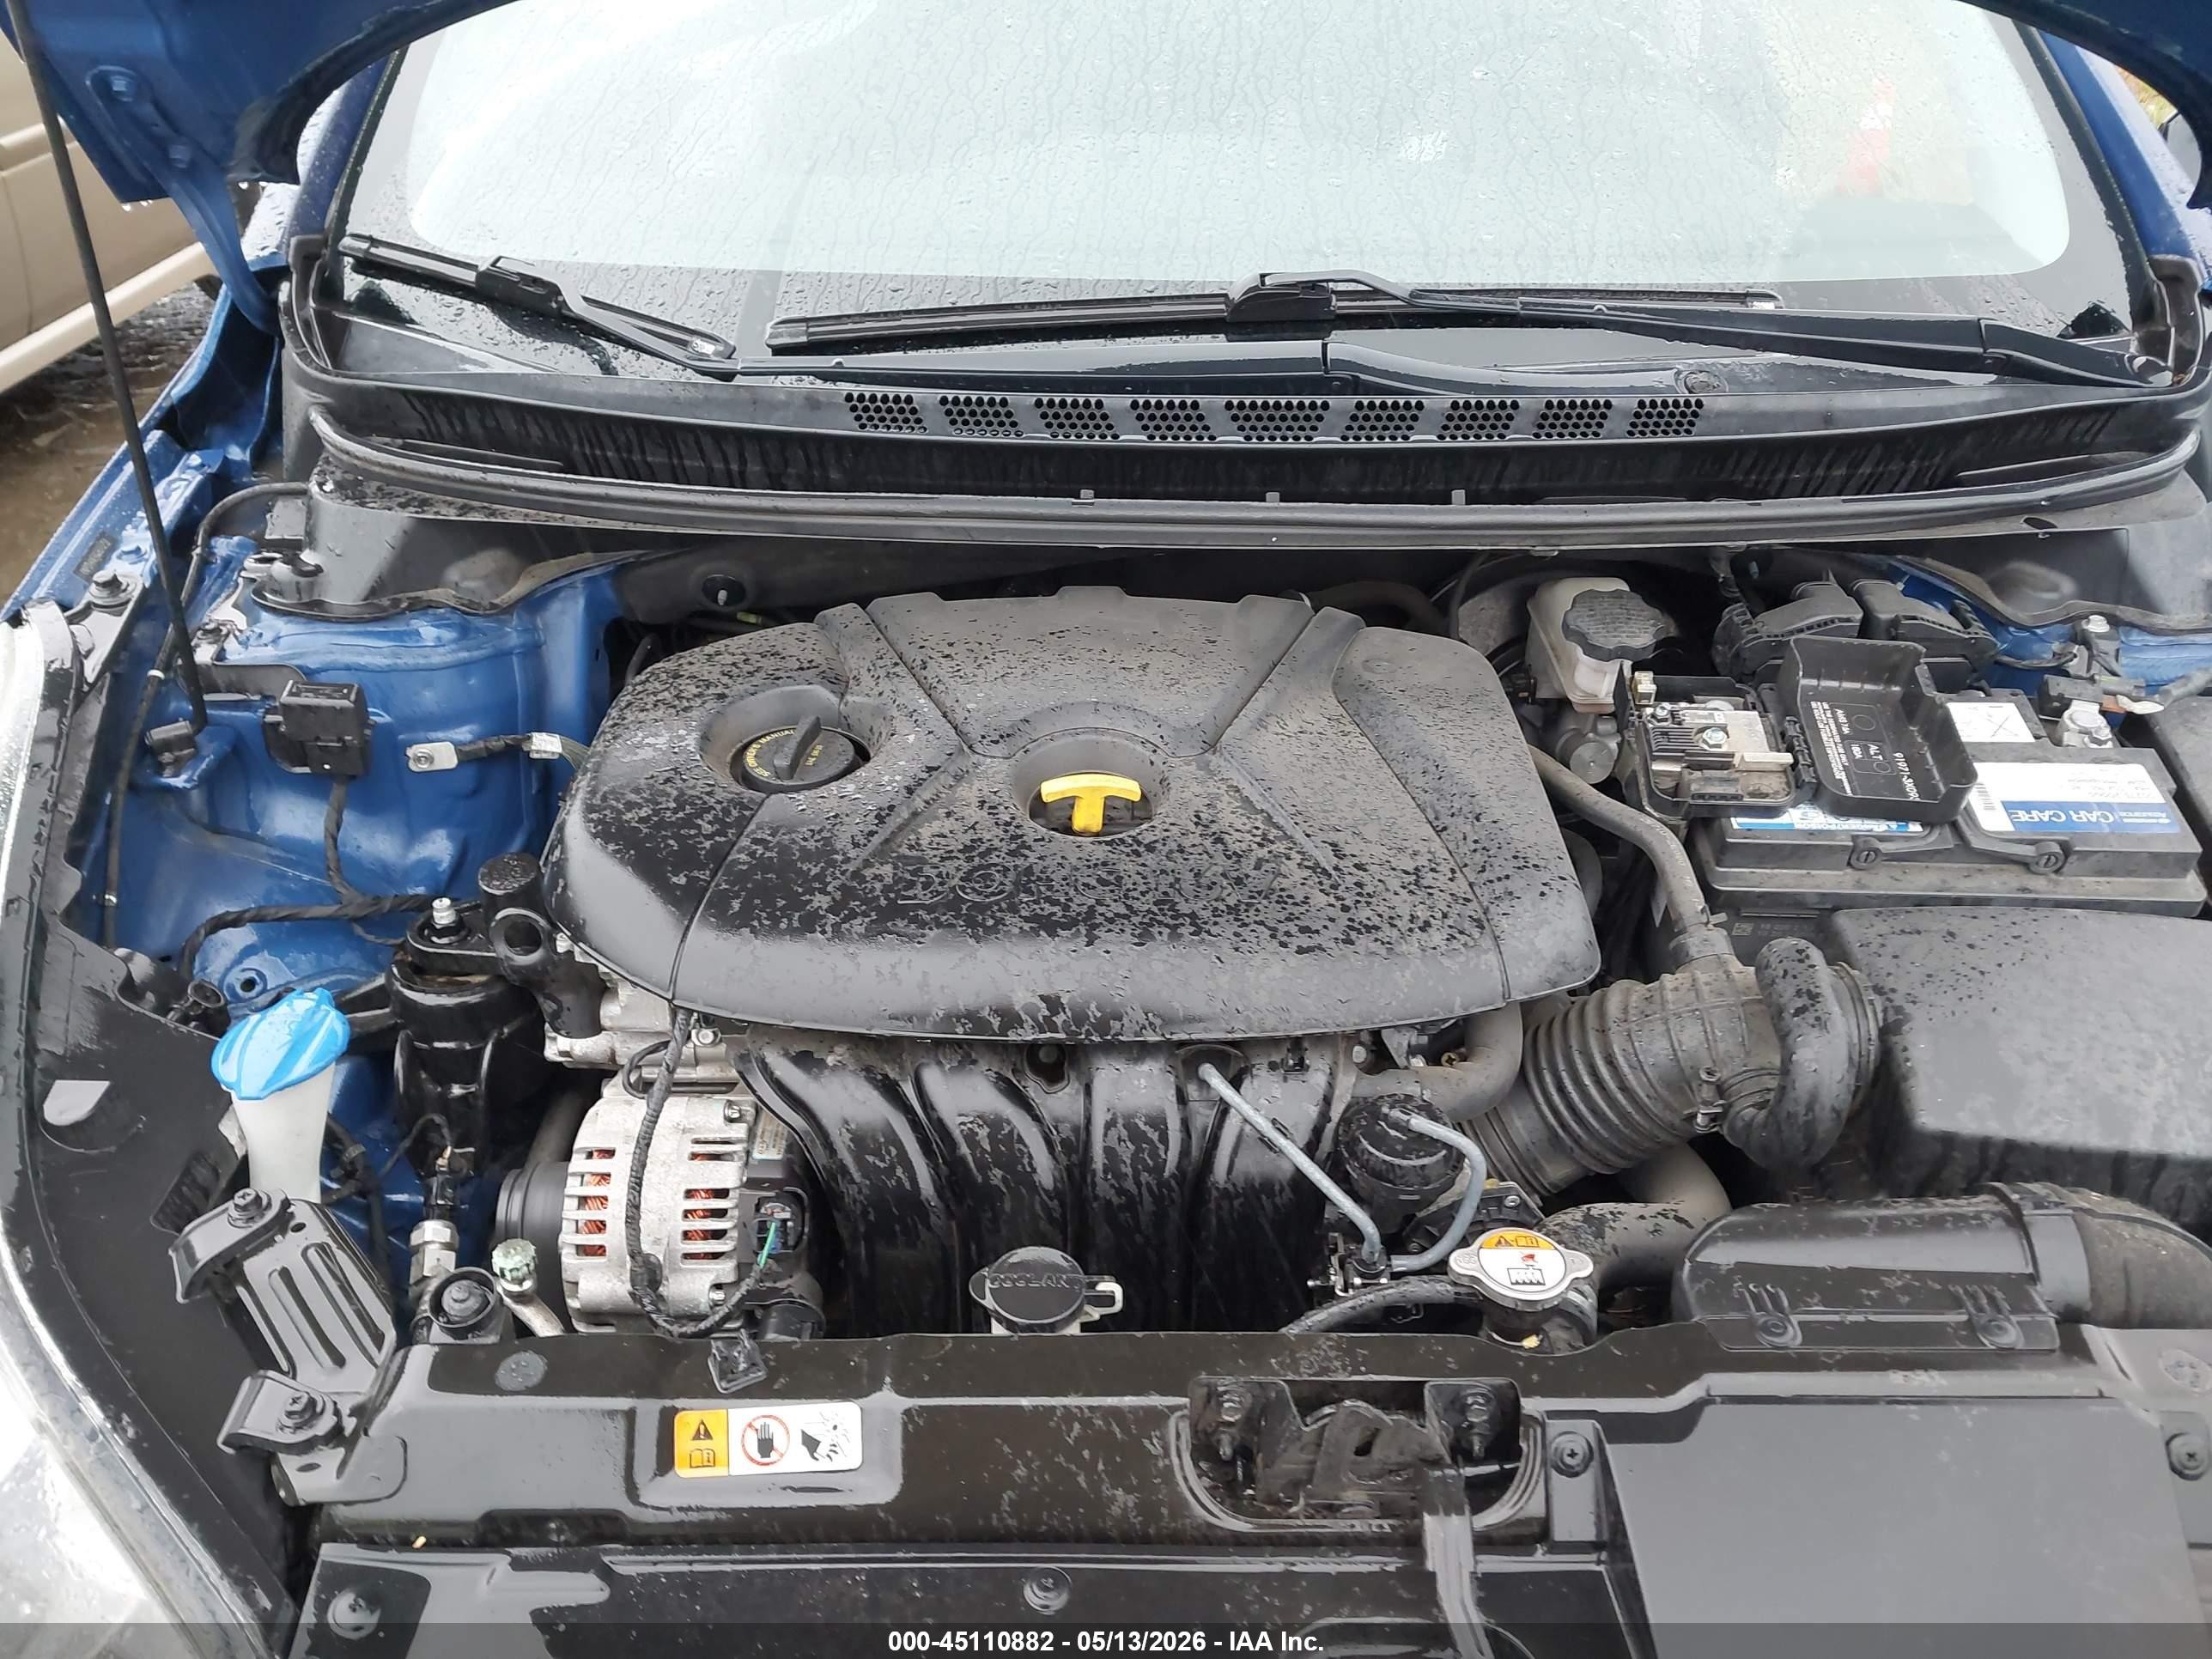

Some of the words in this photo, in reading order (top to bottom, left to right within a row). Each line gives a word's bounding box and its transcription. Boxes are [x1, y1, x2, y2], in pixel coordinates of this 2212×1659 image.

[1868, 744, 1883, 760] ALT
[753, 767, 771, 777] SEE
[2008, 810, 2066, 822] CARE
[2069, 810, 2114, 823] CAR
[988, 1273, 1084, 1292] COOLANT
